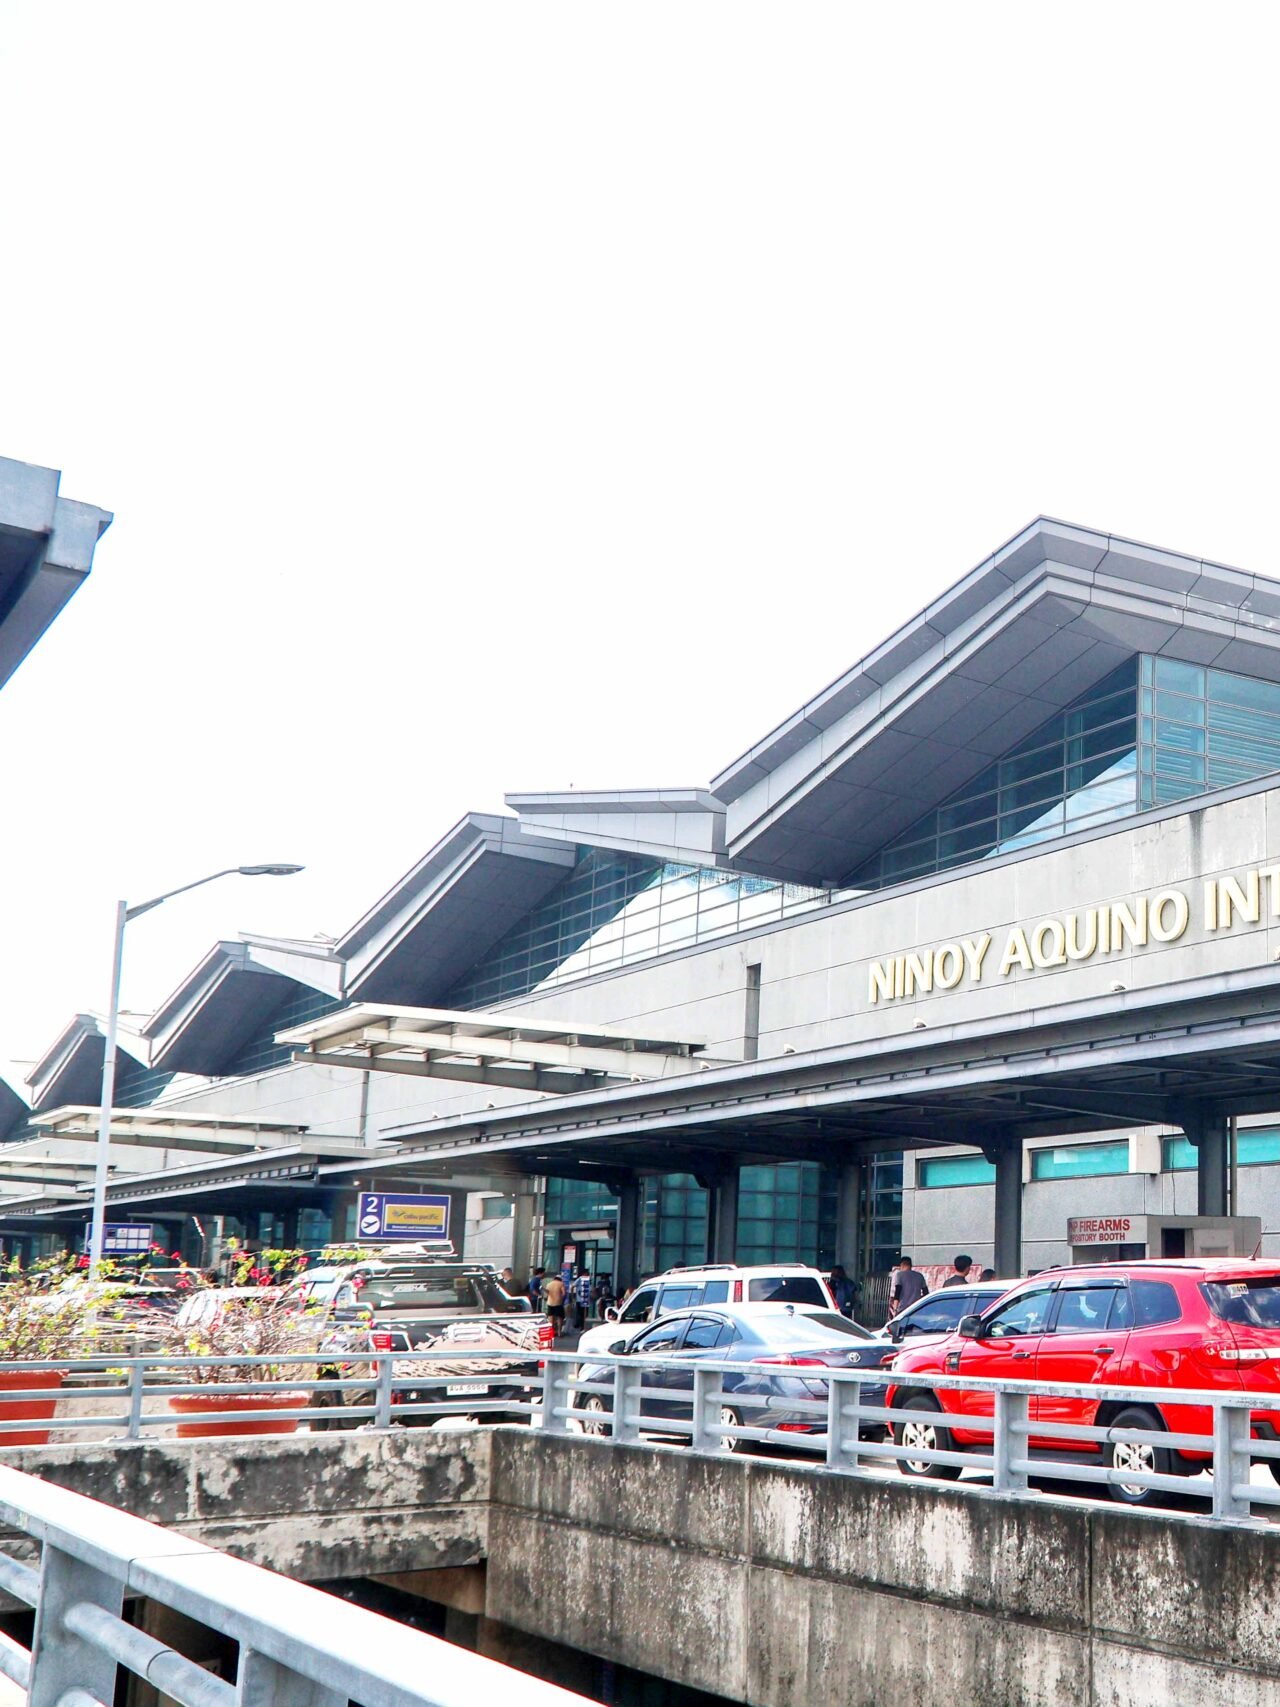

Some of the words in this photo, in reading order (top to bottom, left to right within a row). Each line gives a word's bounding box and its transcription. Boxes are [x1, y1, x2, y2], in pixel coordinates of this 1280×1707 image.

[868, 933, 991, 1004] NINOY
[998, 888, 1190, 976] AQUINO
[366, 1196, 378, 1213] 2
[1080, 1219, 1130, 1232] FIREARMS
[1099, 1232, 1125, 1242] BOOTH
